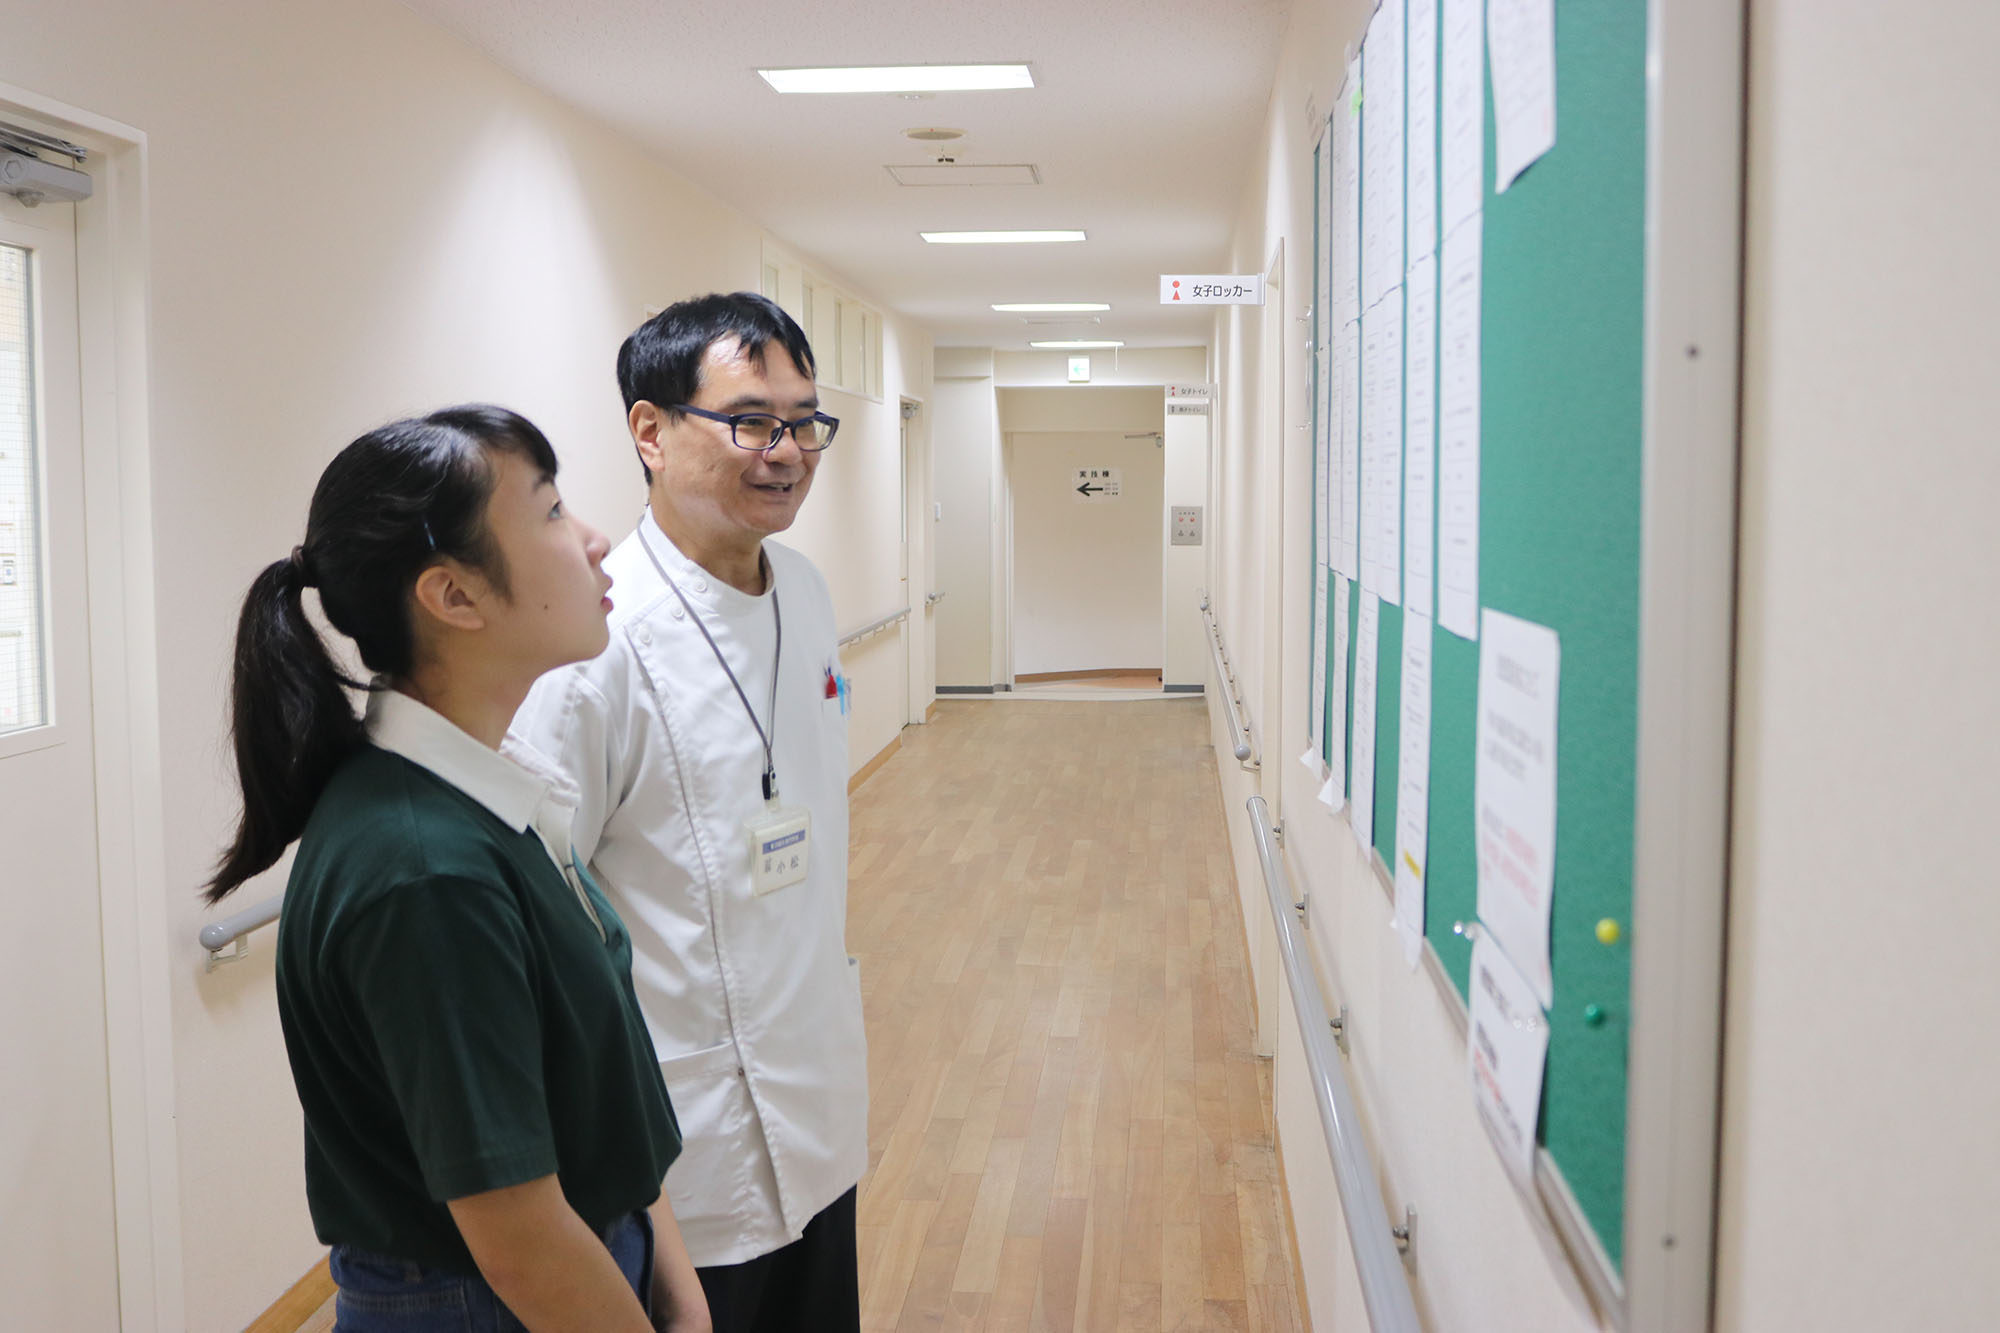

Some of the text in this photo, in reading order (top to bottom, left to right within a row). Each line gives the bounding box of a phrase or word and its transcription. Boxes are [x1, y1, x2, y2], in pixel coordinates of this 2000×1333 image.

[1192, 284, 1253, 298] 女子ロッカー
[1181, 388, 1208, 396] 女子トイレ
